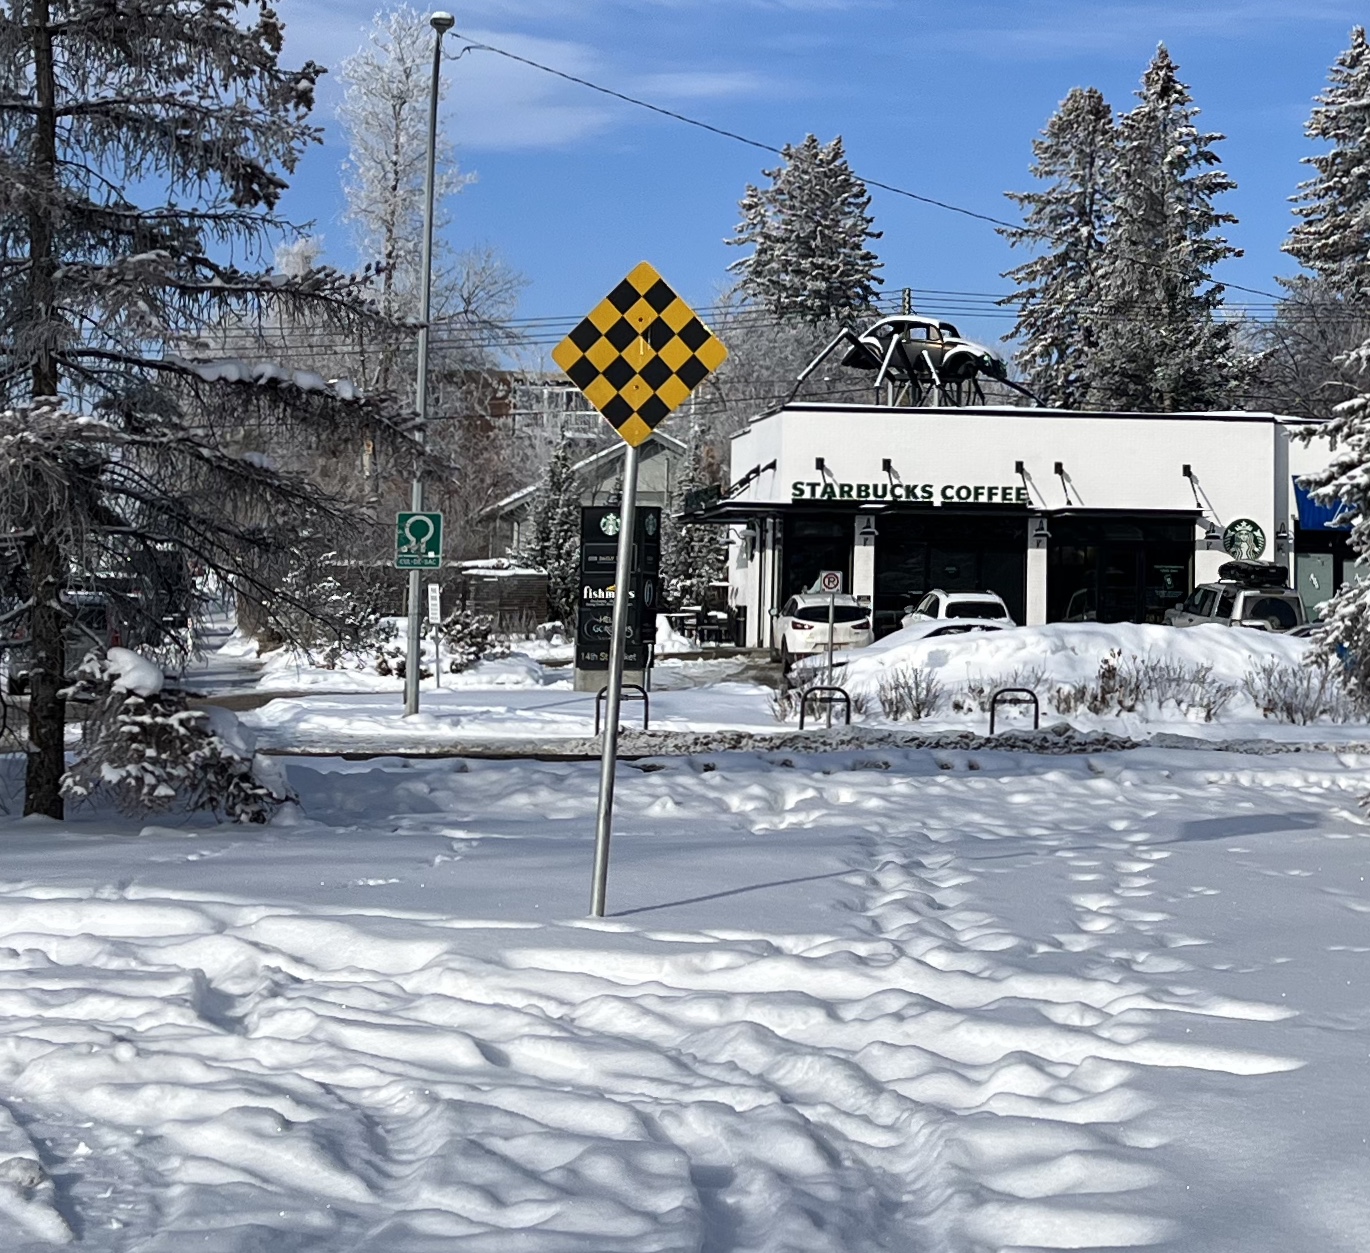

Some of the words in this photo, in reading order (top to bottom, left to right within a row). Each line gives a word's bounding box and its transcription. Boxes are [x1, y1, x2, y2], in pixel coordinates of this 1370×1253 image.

[791, 481, 934, 500] STARBUCKS
[940, 484, 1029, 502] COFFEE
[583, 585, 636, 599] fishms
